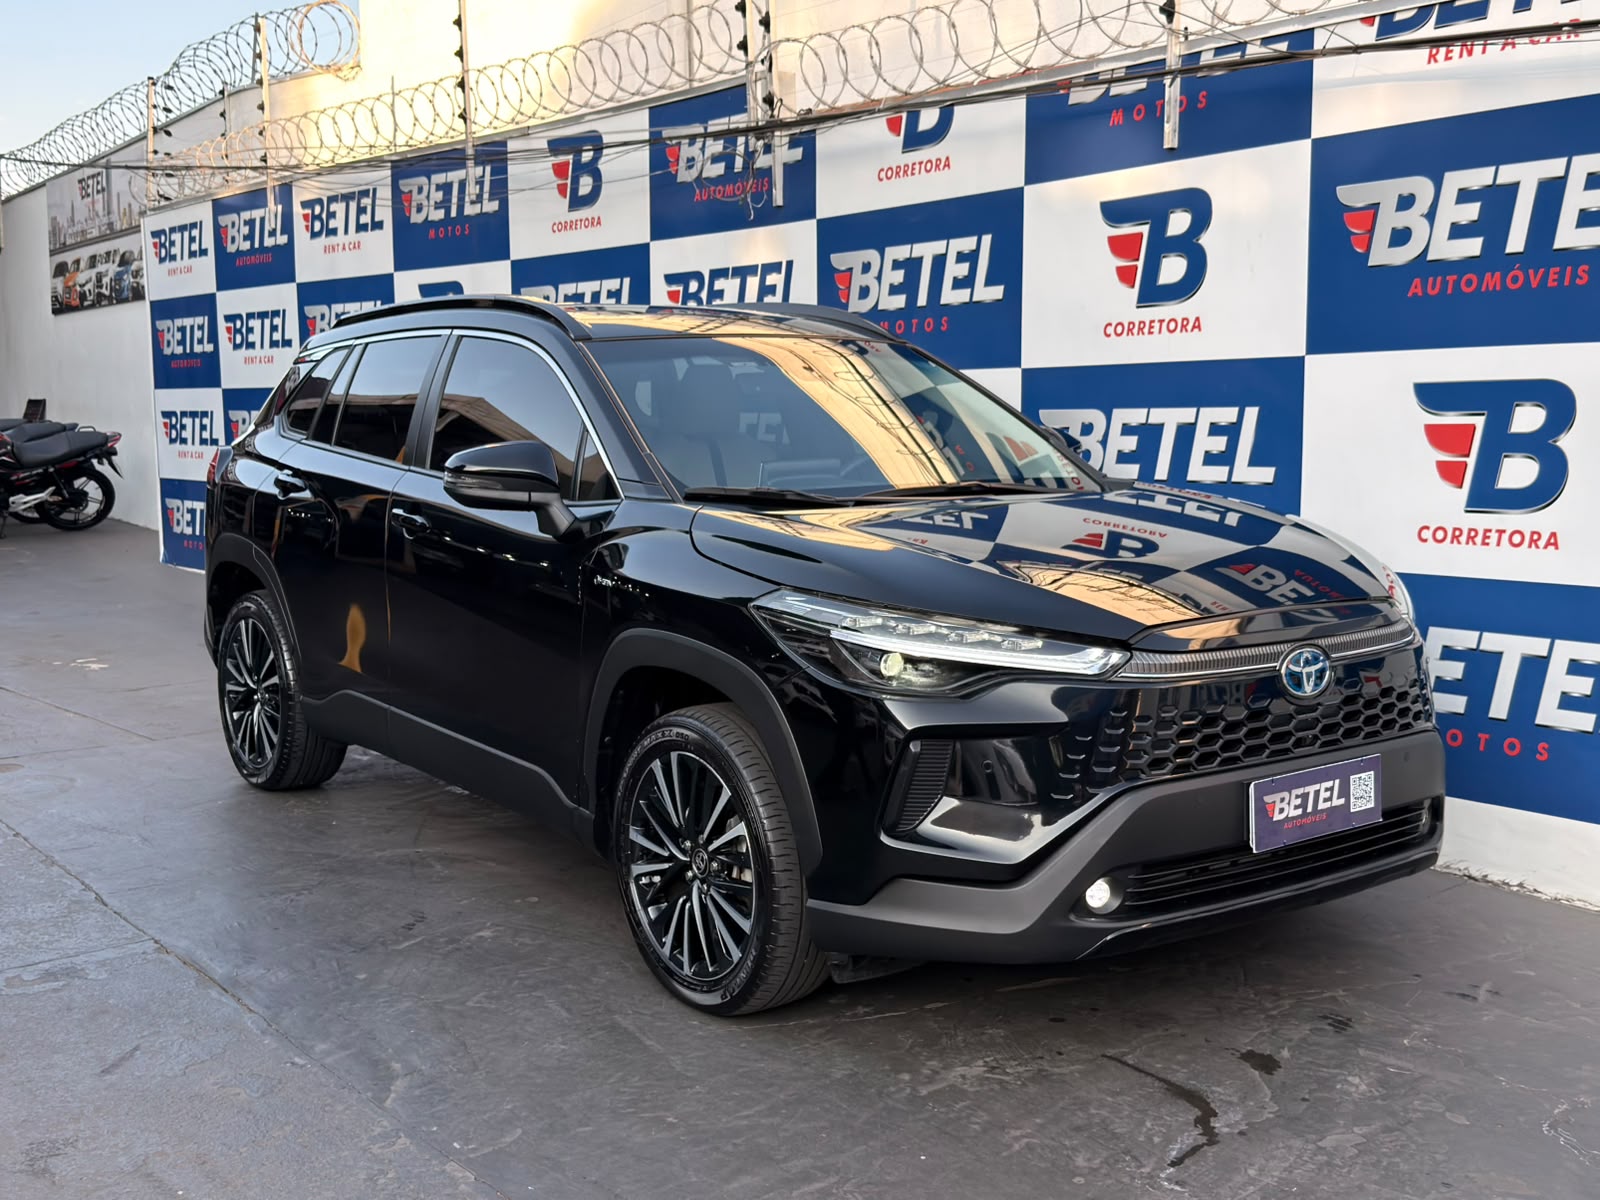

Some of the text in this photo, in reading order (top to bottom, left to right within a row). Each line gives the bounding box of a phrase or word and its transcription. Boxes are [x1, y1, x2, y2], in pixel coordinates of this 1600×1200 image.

[77, 171, 106, 200] BETEL
[878, 156, 951, 182] CORRETORA
[399, 164, 499, 225] BETEL
[694, 177, 769, 202] AUTOMÓVEIS
[218, 204, 289, 254] BETEL
[300, 187, 384, 241] BETEL
[428, 223, 470, 240] MOTOS
[551, 216, 602, 234] CORRETORA
[151, 220, 209, 265] BETEL
[235, 253, 273, 267] AUTOMÓVEIS
[323, 240, 362, 255] RENT A CAR
[1099, 187, 1213, 309] B
[830, 233, 1005, 313] BETEL
[1407, 264, 1590, 297] AUTOMÓVEIS
[156, 315, 214, 356] BETEL
[224, 308, 293, 351] BETEL
[1103, 316, 1203, 338] CORRETORA
[244, 355, 275, 365] RENT A CAR
[161, 410, 220, 447] BETEL
[1039, 405, 1277, 485] BETEL
[1413, 378, 1577, 514] B
[165, 497, 206, 536] BET
[1417, 525, 1560, 551] CORRETORA
[1263, 779, 1346, 822] BETEL
[1283, 812, 1328, 829] AUTOMÓVEIS
